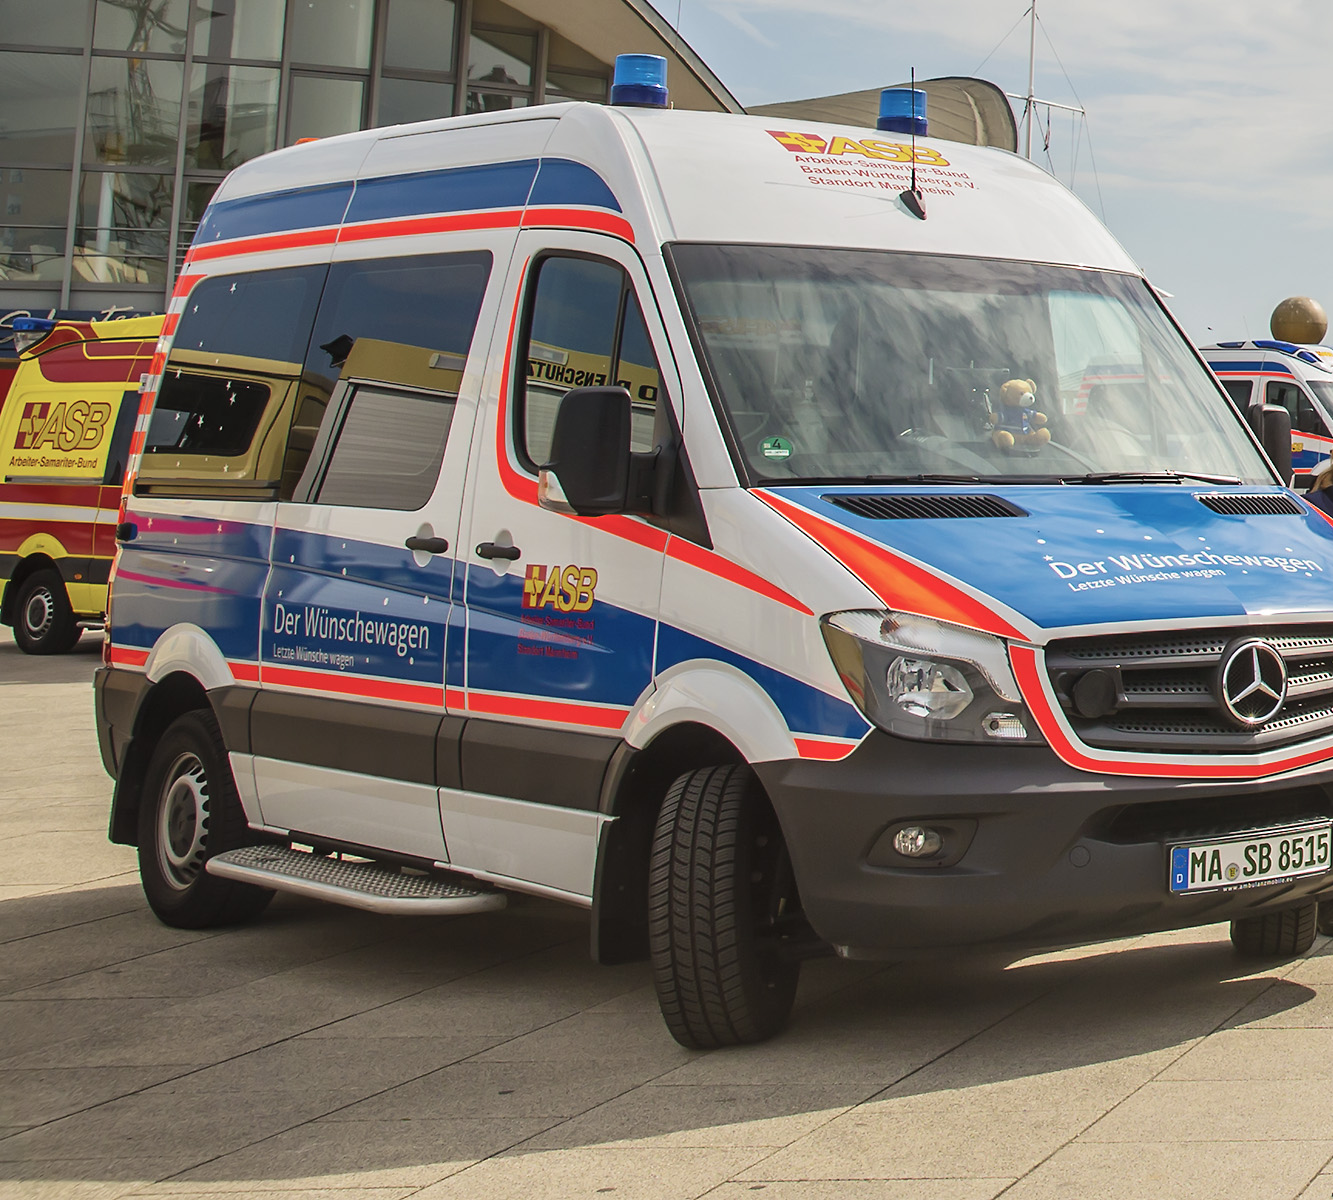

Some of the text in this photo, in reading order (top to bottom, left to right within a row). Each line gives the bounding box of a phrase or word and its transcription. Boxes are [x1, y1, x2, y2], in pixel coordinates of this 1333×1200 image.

[827, 136, 951, 167] ASB
[795, 155, 969, 179] Arbeiter-Samarier-Bund
[808, 176, 877, 189] Standort
[954, 180, 980, 190] e.V.
[32, 400, 112, 452] ASB
[772, 439, 781, 449] 4
[9, 456, 98, 469] Arbeiter-Samariter-Bund
[1049, 550, 1323, 579] Der Wünschewagen
[538, 564, 598, 614] ASB
[1068, 568, 1226, 592] Letzte Wünsche wagen
[274, 604, 430, 657] Der Wünschewagen
[273, 643, 354, 670] Letzte Wünsche wagen
[1190, 833, 1329, 884] MA SB 8515
[1176, 873, 1184, 884] D
